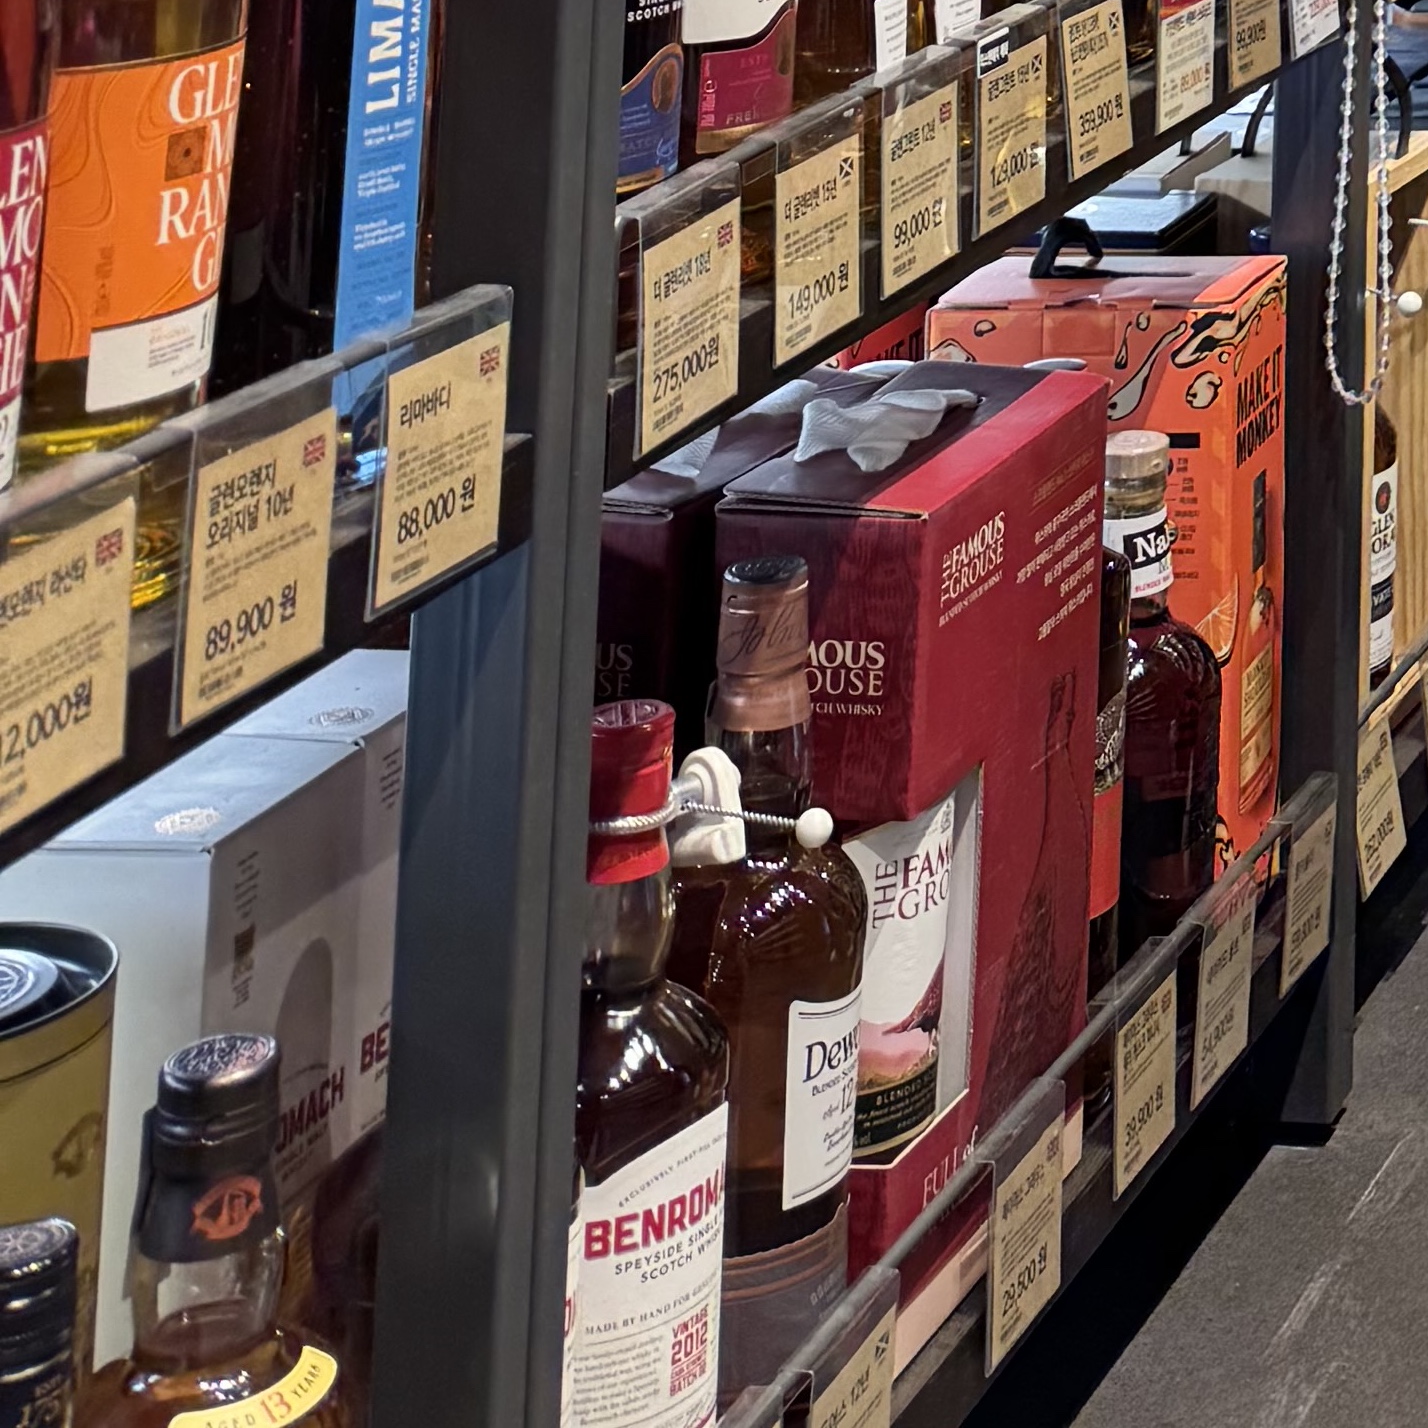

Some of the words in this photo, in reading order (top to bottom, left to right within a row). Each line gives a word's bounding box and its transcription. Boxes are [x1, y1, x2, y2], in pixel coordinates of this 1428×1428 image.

[892, 205, 931, 250] 99,000
[787, 271, 836, 321] 149,000
[652, 332, 720, 404] 275,000원
[1236, 354, 1270, 429] MAKE
[400, 381, 452, 431] 리마바디
[1236, 397, 1283, 469] MONKEY
[205, 496, 261, 551] 오리지널
[263, 484, 296, 526] 10년
[209, 458, 278, 518] 글렌모렌지
[396, 493, 457, 546] 88,000
[459, 472, 478, 518] 원
[948, 537, 1005, 600] GROUSE
[949, 510, 1006, 576] FAMOUS
[205, 594, 275, 665] 89,900
[277, 577, 299, 626] 원
[872, 859, 899, 931] THE
[614, 1241, 684, 1276] SPEYSIDE
[640, 1251, 694, 1285] SCOTCH
[670, 1321, 709, 1366] 2012
[259, 1389, 293, 1426] 13
